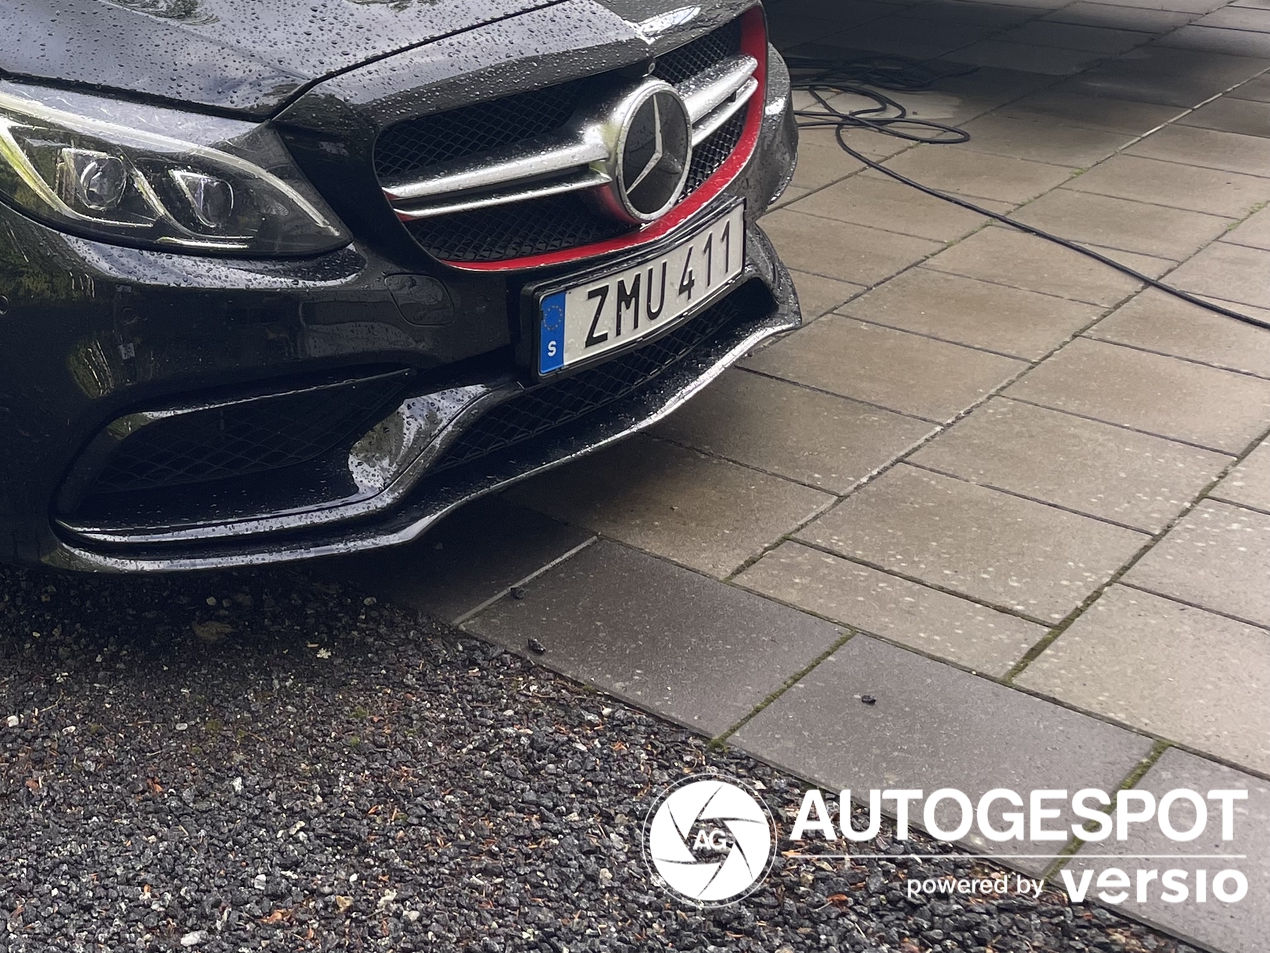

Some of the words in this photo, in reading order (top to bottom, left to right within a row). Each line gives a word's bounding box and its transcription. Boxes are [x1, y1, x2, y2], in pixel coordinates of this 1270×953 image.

[584, 260, 667, 348] ZMU
[677, 218, 731, 301] 411
[547, 340, 557, 357] S
